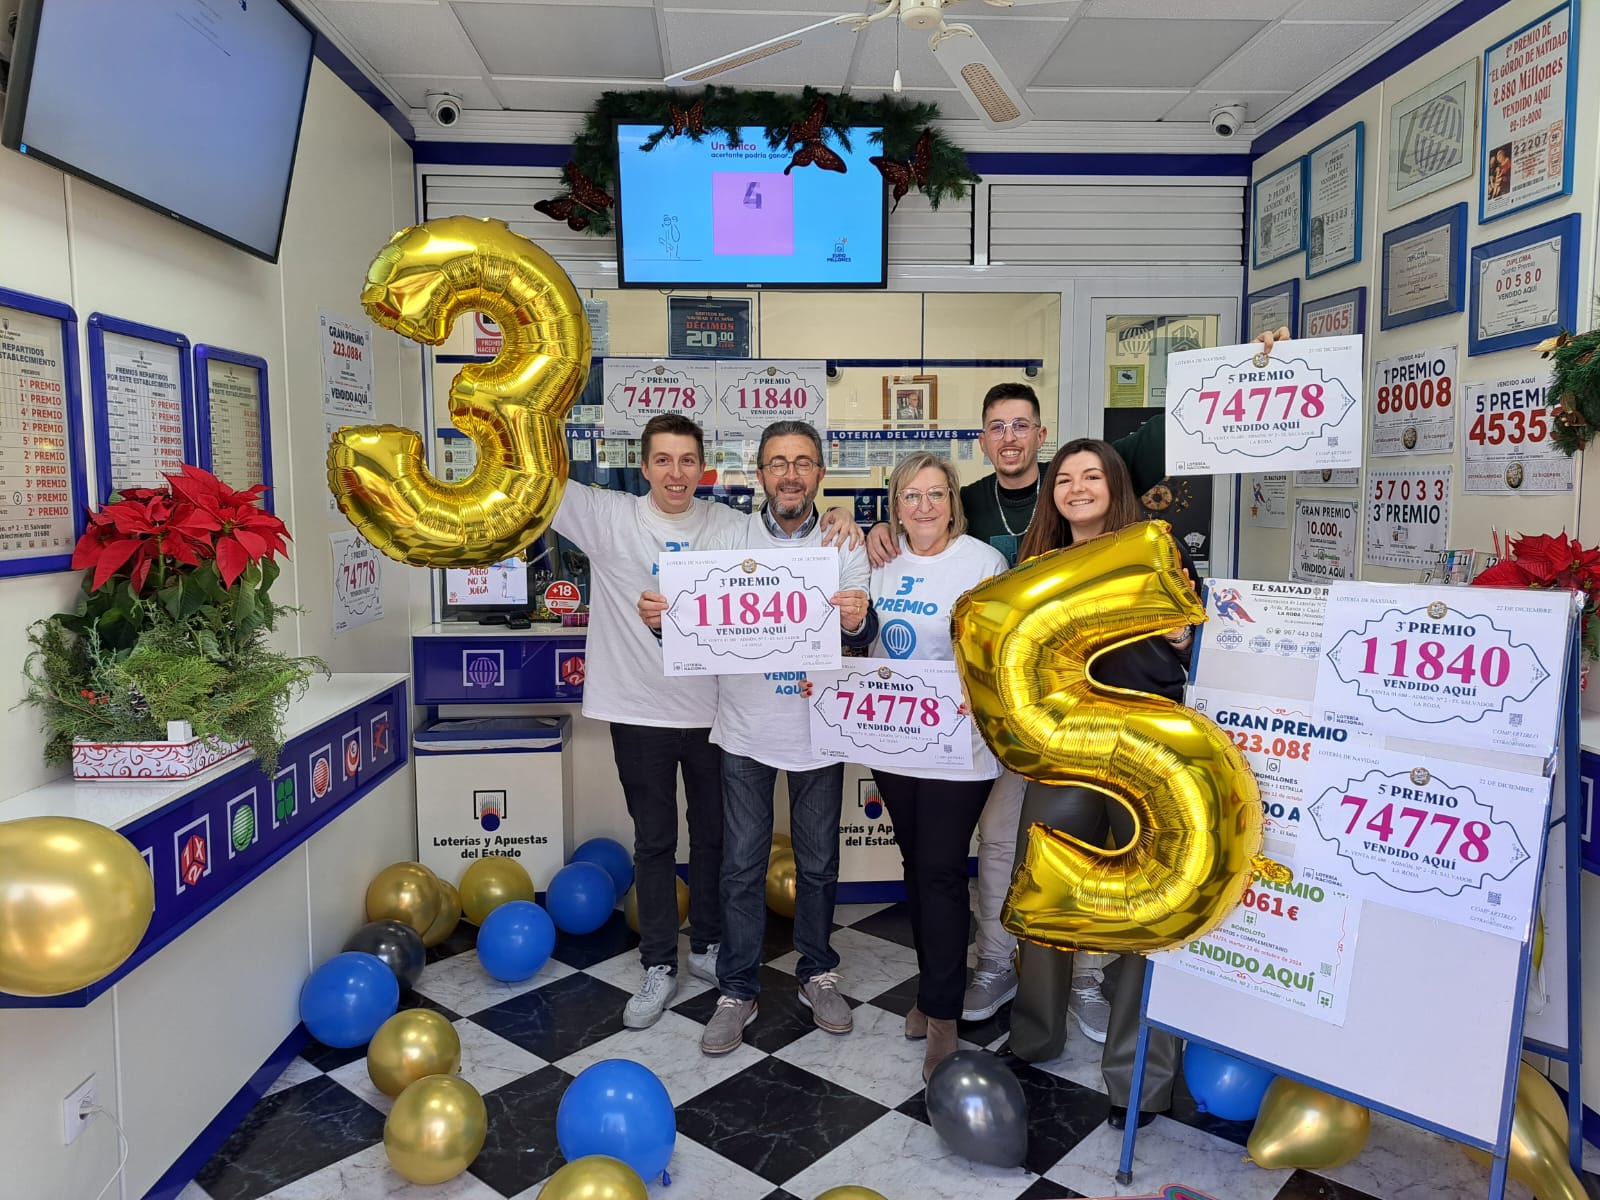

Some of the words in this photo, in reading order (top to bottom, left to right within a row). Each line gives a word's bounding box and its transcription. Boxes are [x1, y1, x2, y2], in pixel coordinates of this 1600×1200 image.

[1514, 28, 1540, 54] PREMIO
[1542, 21, 1552, 38] DE
[1500, 54, 1524, 78] GORDO
[1525, 49, 1534, 64] DE
[1536, 31, 1568, 59] NAVIDAD
[1519, 56, 1564, 93] Millones
[1502, 94, 1532, 120] VENDIDO
[1533, 80, 1552, 105] AQUÍ
[711, 142, 724, 150] Un
[1514, 132, 1548, 156] 22207
[744, 182, 762, 209] 4
[1506, 254, 1532, 266] DIPLOMA
[1496, 268, 1542, 292] 00580
[1498, 289, 1522, 300] VENDIDO
[1310, 309, 1349, 336] 67065
[329, 326, 346, 340] GRAN
[346, 332, 364, 346] PREMIO
[2, 342, 44, 356] REPARTIDOS
[116, 366, 138, 376] PREMIOS
[139, 370, 168, 382] REPARTIDOS
[1238, 370, 1294, 382] PREMIO
[1392, 359, 1446, 384] PREMIO
[30, 380, 60, 392] PREMIO
[120, 375, 132, 384] ESTE
[133, 376, 176, 390] ESTABLECIMIENTO
[1498, 380, 1520, 388] VENDIDO
[327, 214, 592, 570] 3
[331, 388, 354, 402] VENDIDO
[354, 391, 368, 406] AQUÍ
[624, 386, 696, 408] 74778
[737, 388, 807, 408] 11840
[1378, 377, 1452, 414] 88008
[30, 394, 62, 406] PREMIO
[158, 400, 180, 410] PREMIO
[1199, 384, 1325, 425] 74778
[1490, 387, 1546, 412] PREMI
[32, 408, 62, 420] PREMIO
[159, 412, 180, 422] PREMIO
[779, 408, 794, 416] AQUÍ
[32, 422, 64, 434] PREMIO
[160, 424, 181, 434] PREMIO
[1222, 424, 1270, 434] VENDIDO
[1272, 418, 1300, 431] AQUÍ
[160, 436, 182, 446] PREMIO
[832, 431, 882, 439] LOTERIA
[914, 430, 958, 438] JUEVES
[34, 437, 64, 448] PREMIO
[34, 451, 65, 460] PREMIO
[160, 448, 182, 457] PREMIO
[36, 466, 66, 475] PREMIO
[36, 480, 67, 488] PREMIO
[1374, 480, 1444, 500] 57033
[38, 494, 68, 502] PREMIO
[38, 506, 68, 516] PREMIO
[1302, 506, 1320, 516] GRAN
[1322, 506, 1350, 519] PREMIO
[1386, 504, 1440, 524] PREMIO
[1307, 520, 1338, 537] 10.000
[1436, 554, 1448, 564] 10
[1458, 554, 1468, 566] 11
[1486, 556, 1498, 568] 12
[344, 560, 376, 592] 74778
[1301, 562, 1326, 574] VENDIDO
[1328, 566, 1346, 578] AQUÍ
[730, 576, 780, 587] PREMIO
[896, 576, 924, 596] 3ER
[1444, 574, 1450, 584] 8
[468, 586, 488, 596] JUEGA
[552, 585, 572, 596] +18
[1252, 584, 1265, 592] EL
[694, 590, 808, 627] 11840
[876, 597, 938, 616] PREMIO
[716, 628, 760, 636] VENDIDO
[762, 624, 786, 635] AQUÍ
[1408, 622, 1476, 638] PREMIO
[1216, 635, 1242, 643] GORDO
[1358, 636, 1510, 688] 11840
[868, 682, 914, 692] PREMIO
[1384, 678, 1440, 693] VENDIDO
[1442, 684, 1477, 698] AQUÍ
[836, 691, 940, 727] 74778
[857, 722, 896, 732] VENDIDO
[898, 724, 920, 734] AQUÍ
[1216, 710, 1268, 731] GRAN
[1272, 716, 1348, 742] PREMIO
[951, 520, 1265, 955] 5
[1498, 782, 1534, 794] DICIEMBRE
[1391, 786, 1458, 808] PREMIO
[868, 826, 874, 836] y
[1340, 794, 1492, 863] 74778
[434, 836, 481, 847] Loterías
[484, 838, 491, 848] y
[495, 834, 548, 846] Apuestas
[846, 836, 862, 846] del
[865, 836, 896, 846] Estad
[461, 848, 478, 858] del
[482, 848, 522, 858] Estado
[1364, 840, 1419, 862] VENDIDO
[1422, 856, 1456, 870] AQUÍ
[1253, 874, 1325, 903] REMIO
[1230, 924, 1266, 938] BONOLOTO
[1240, 934, 1288, 954] COMPLEMENTARIO
[1188, 940, 1260, 974] ENDIDO
[1262, 964, 1316, 992] AQUÍ
